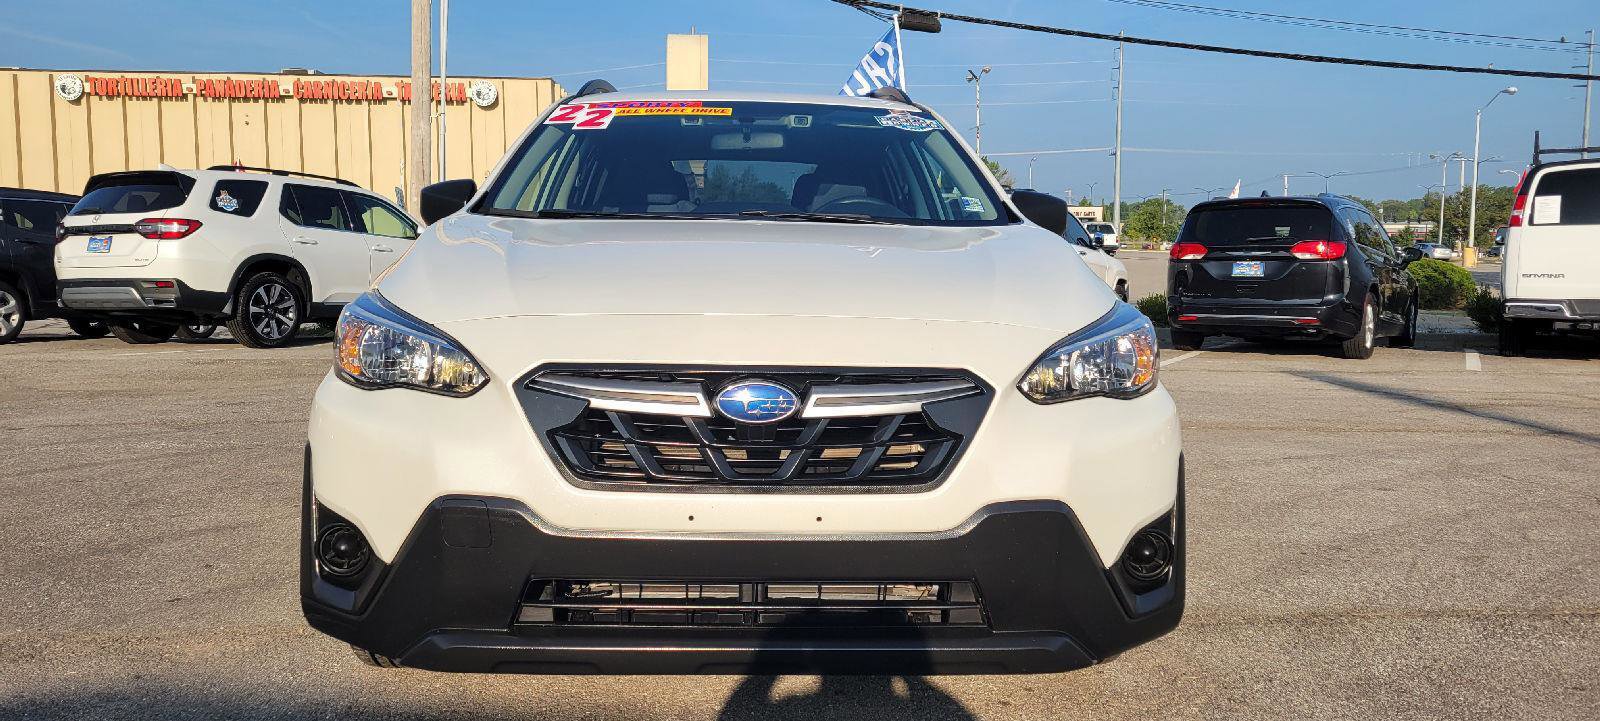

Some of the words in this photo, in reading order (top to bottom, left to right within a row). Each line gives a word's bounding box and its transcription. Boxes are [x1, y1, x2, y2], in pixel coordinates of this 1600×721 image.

[88, 77, 183, 97] TORTILLERIA
[195, 79, 280, 98] PANADERIA
[292, 80, 384, 100] CARNICERIA
